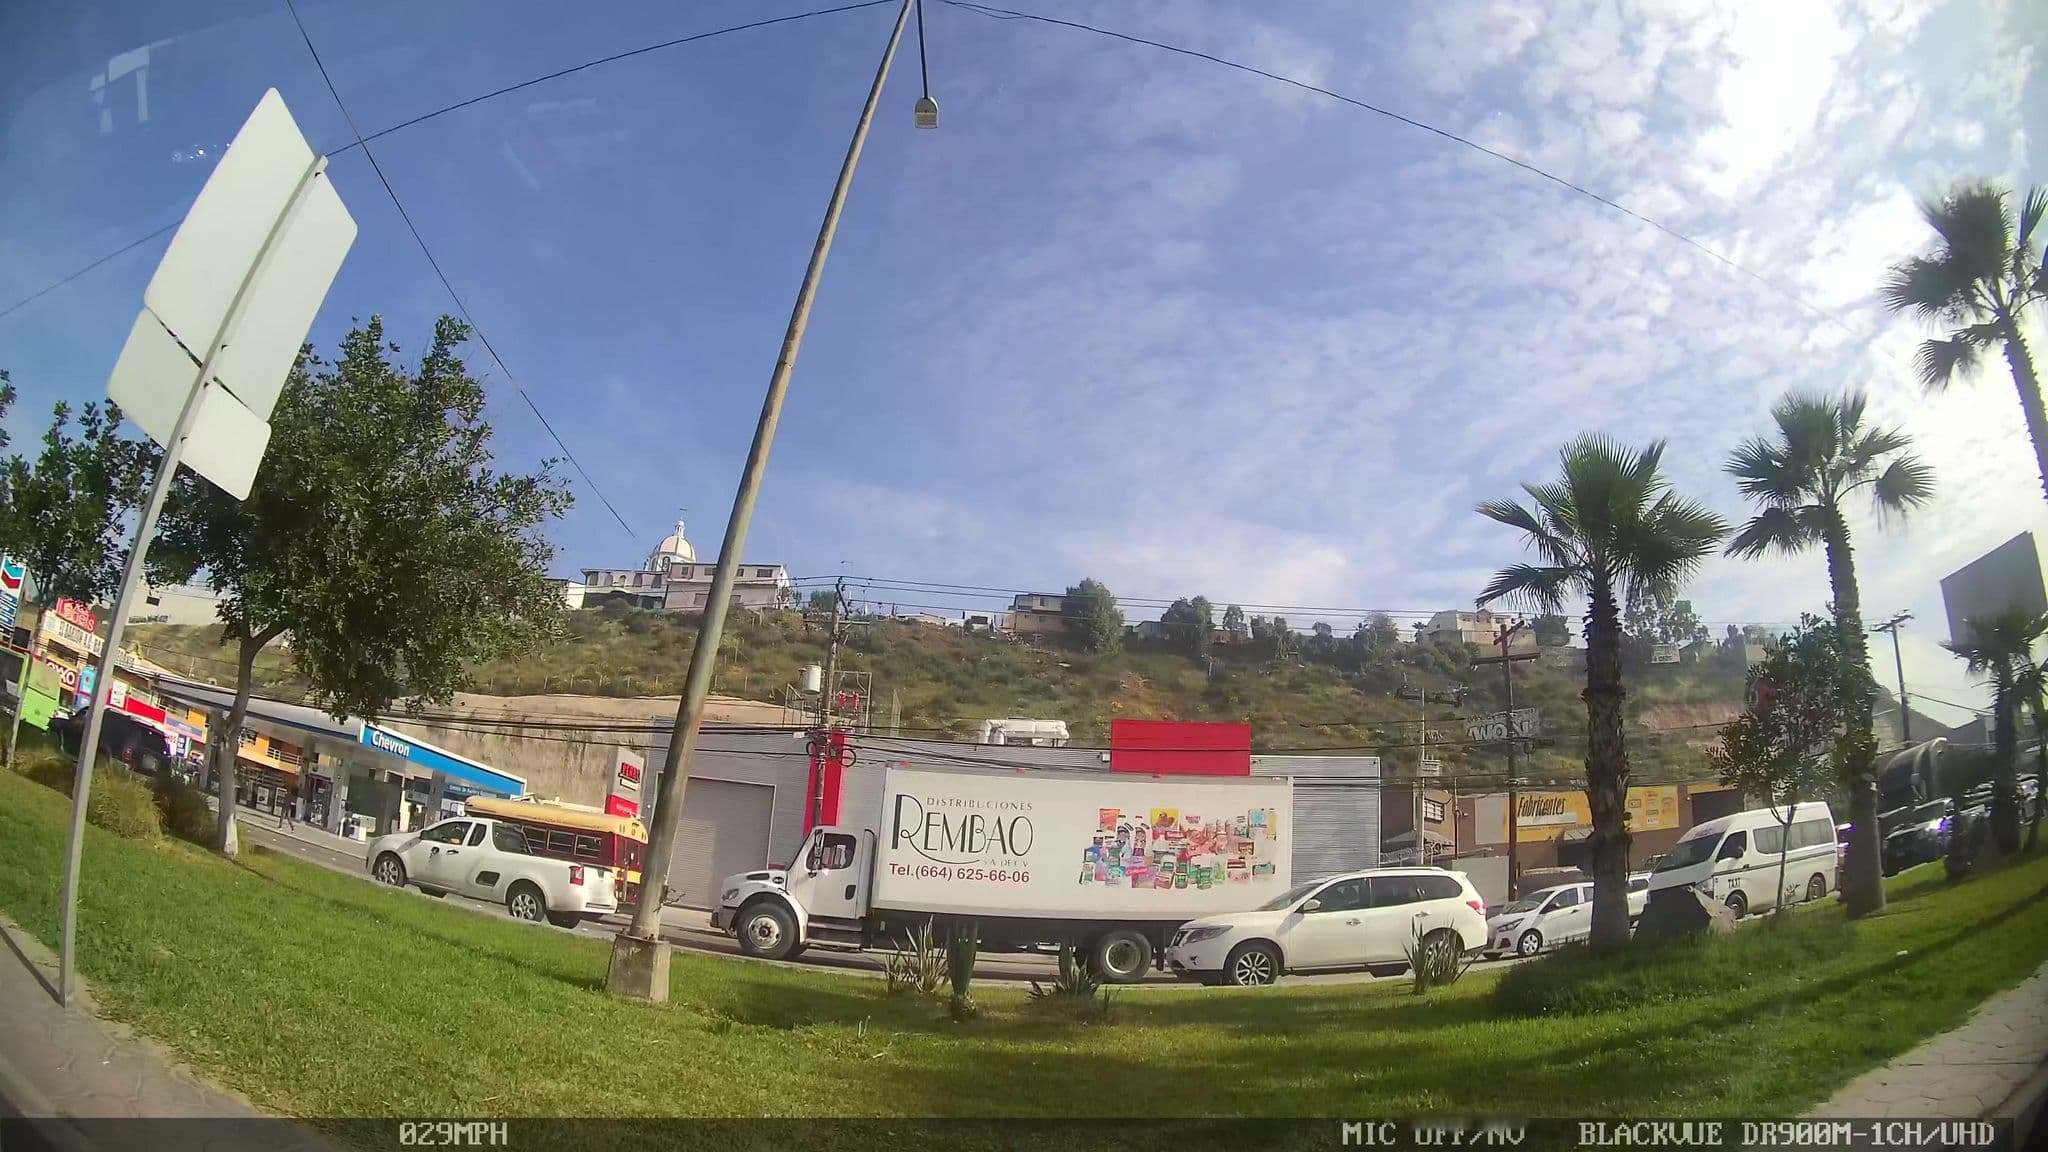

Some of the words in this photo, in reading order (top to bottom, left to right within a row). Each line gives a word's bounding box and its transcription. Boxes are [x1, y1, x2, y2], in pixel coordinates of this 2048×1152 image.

[372, 730, 411, 757] Chevron
[926, 797, 1033, 811] DISTRIBUCIONES
[891, 794, 1034, 865] REMBAO
[956, 869, 1030, 883] 625-66-06
[1727, 877, 1741, 889] TAXI
